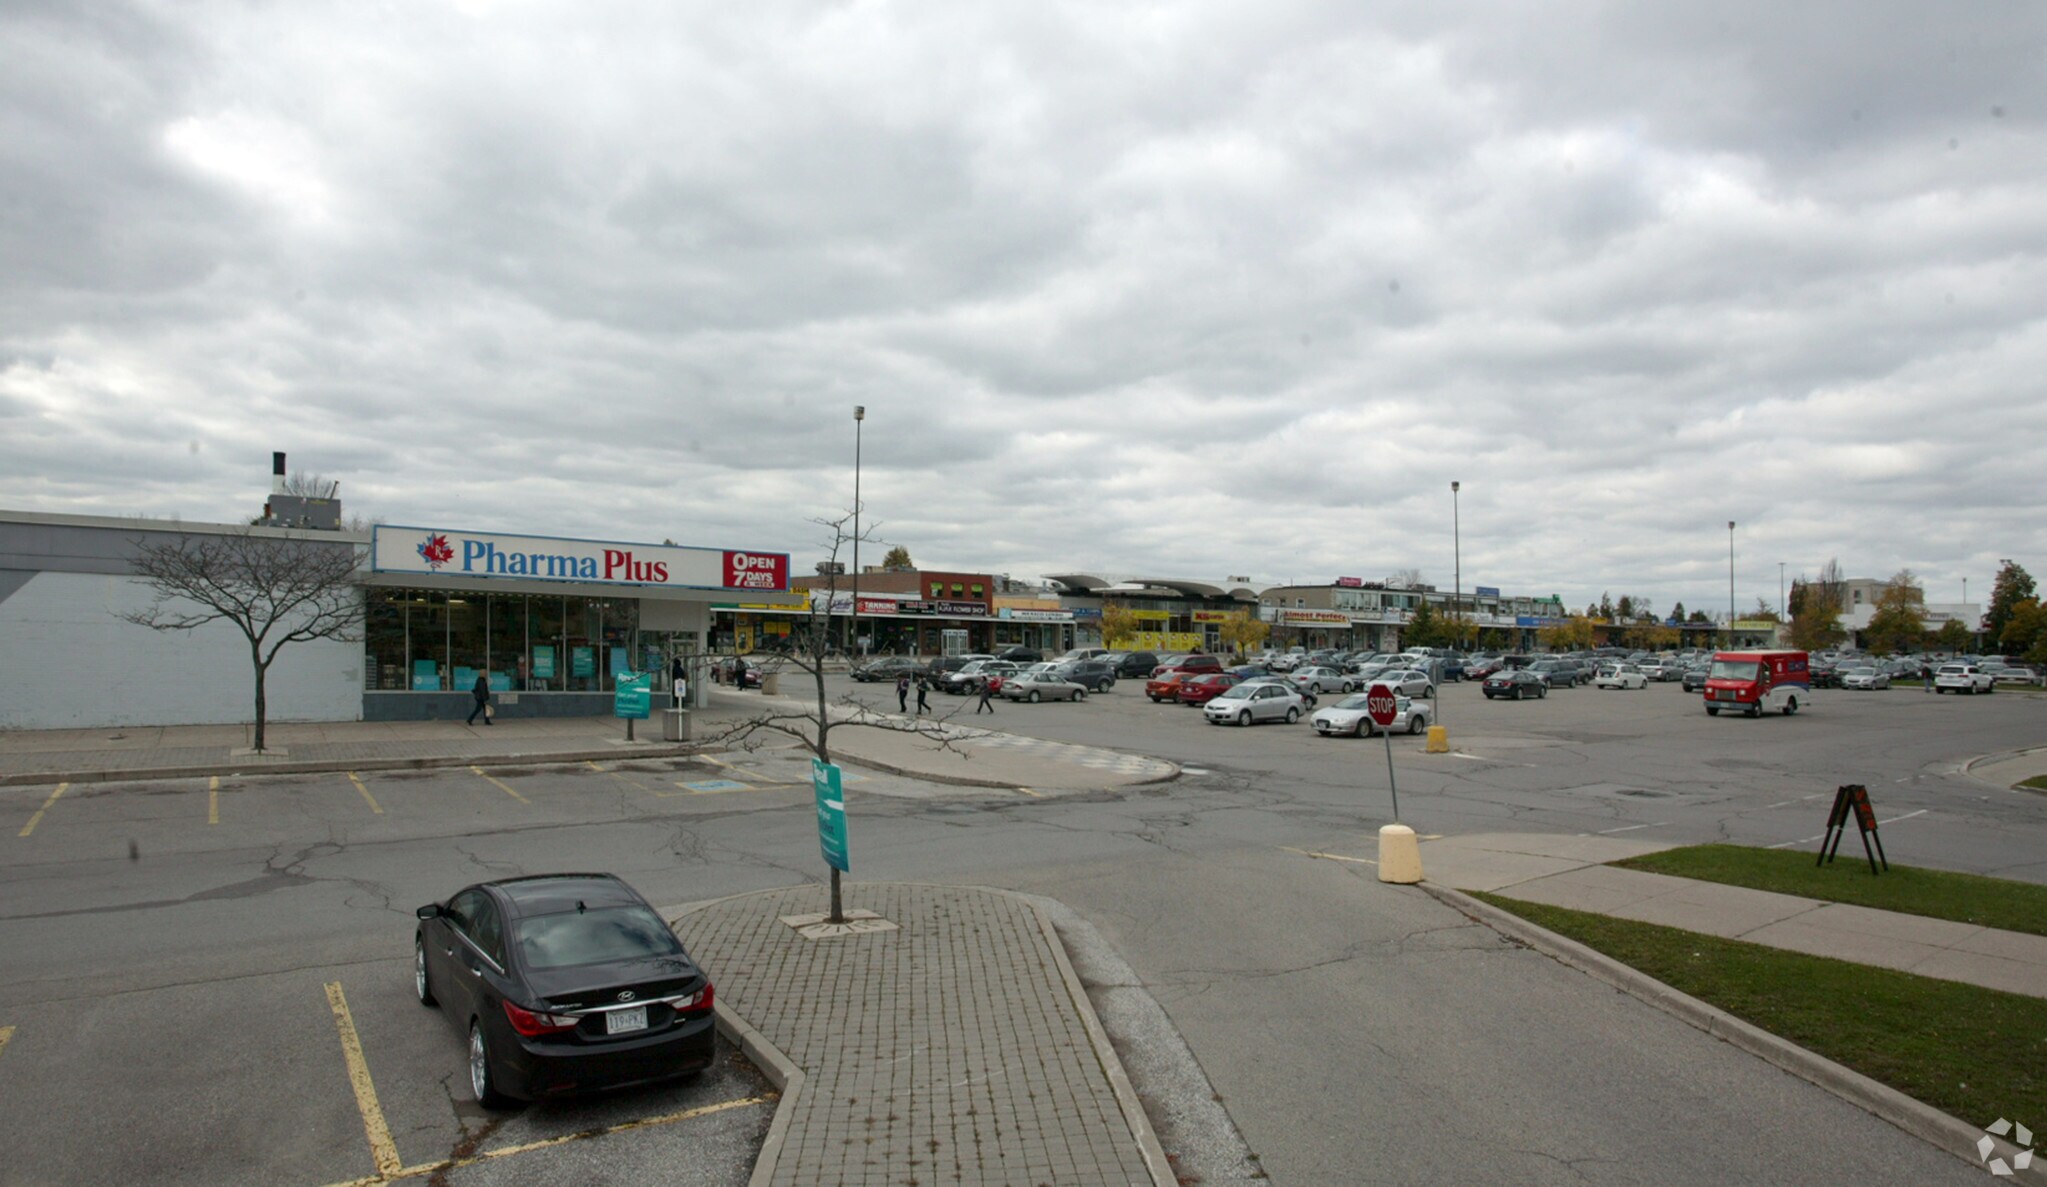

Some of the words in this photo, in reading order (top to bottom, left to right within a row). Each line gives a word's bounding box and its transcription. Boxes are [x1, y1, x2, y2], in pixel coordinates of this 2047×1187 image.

[462, 539, 598, 578] Pharma
[602, 549, 669, 582] Plus
[733, 570, 746, 586] 7
[747, 571, 773, 582] DAYS
[1369, 697, 1394, 713] STOP
